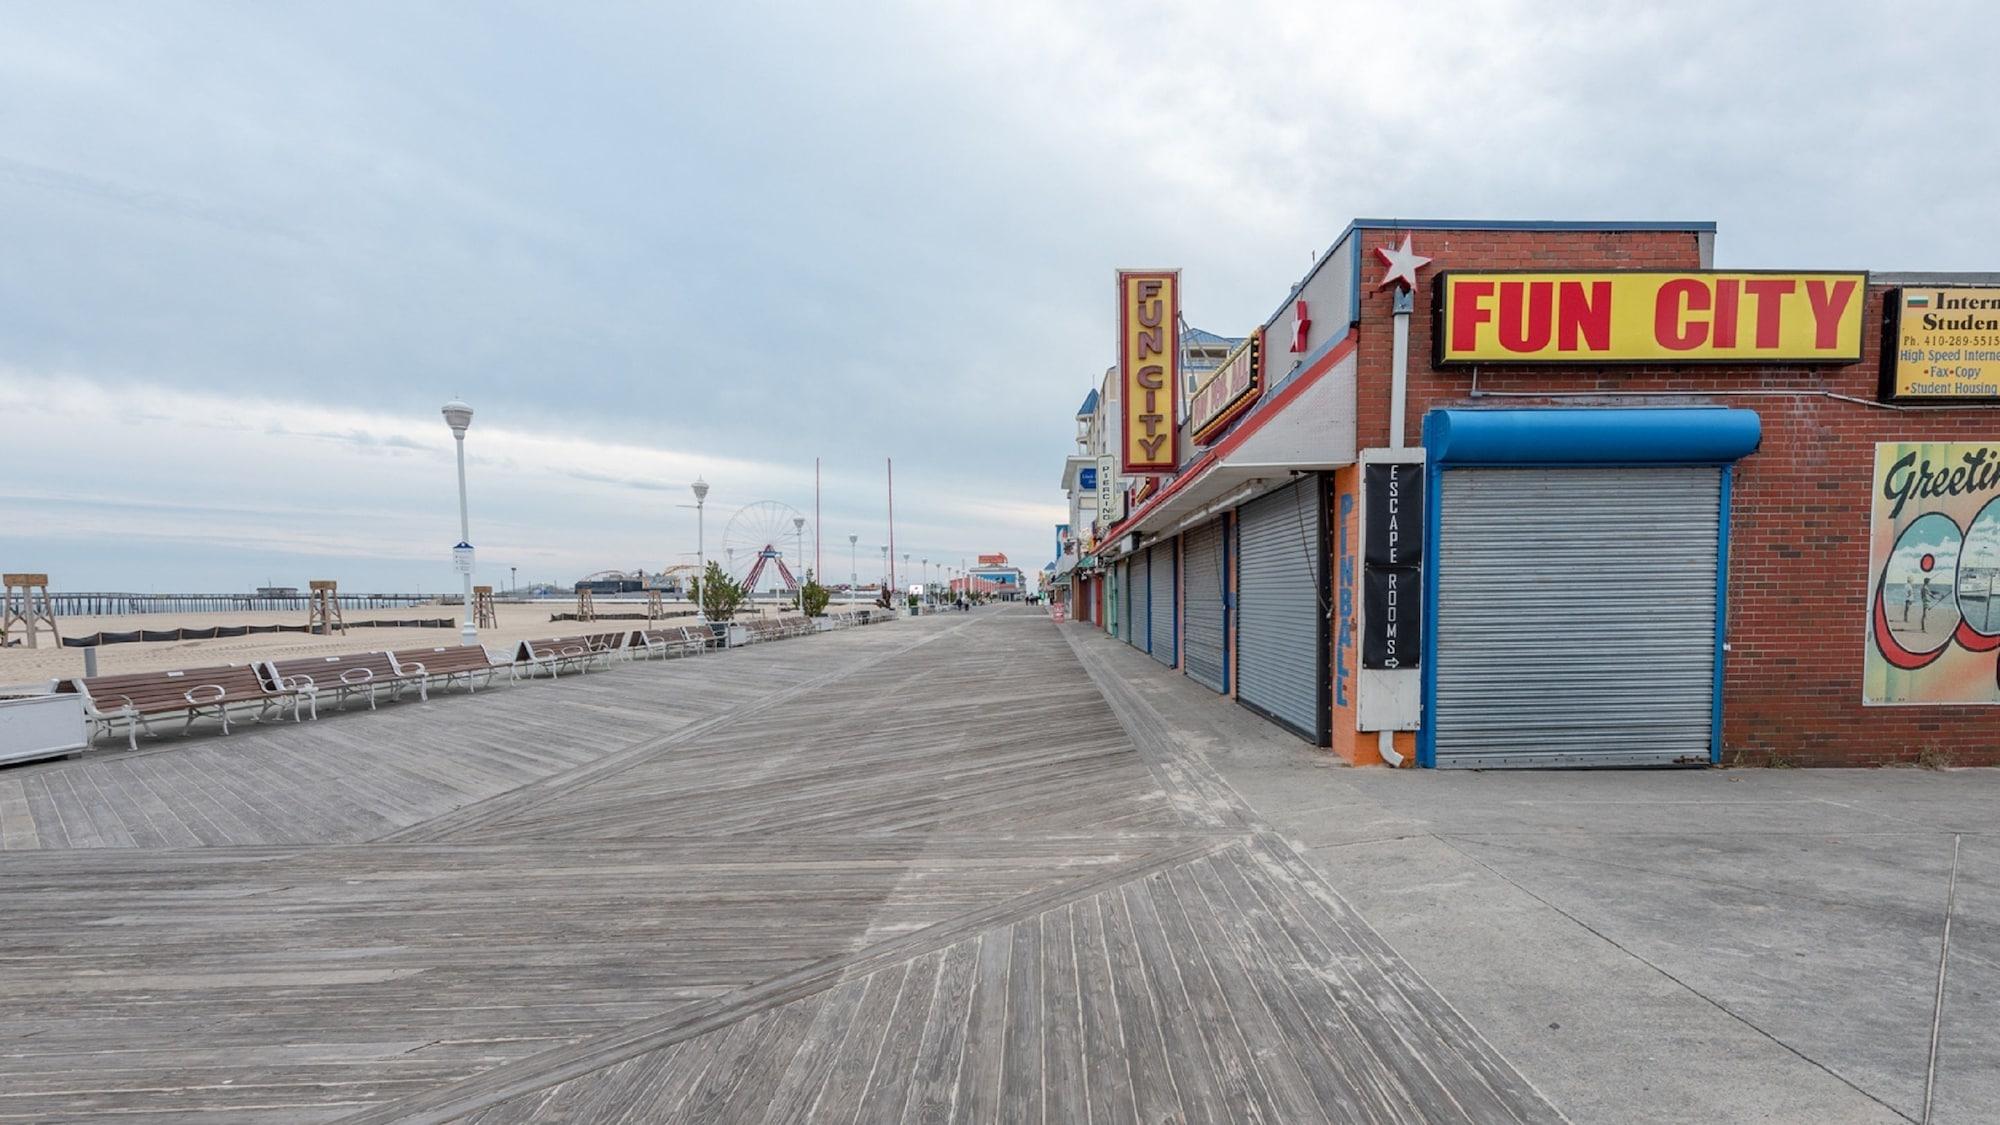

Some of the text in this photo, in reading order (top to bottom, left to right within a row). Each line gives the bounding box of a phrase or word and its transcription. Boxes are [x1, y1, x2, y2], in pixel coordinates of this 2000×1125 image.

[1936, 292, 2000, 310] Intern
[1452, 278, 1857, 353] FUN CITY
[1923, 313, 1998, 330] Studen
[1903, 335, 1920, 346] Ph.
[1900, 349, 1925, 363] High
[1928, 349, 1960, 363] Speed
[1137, 280, 1167, 461] FUN CITY
[1911, 382, 1998, 395] Student Housing
[1386, 465, 1399, 655] ESCAPE ROOMS
[1336, 493, 1354, 707] PINBALL
